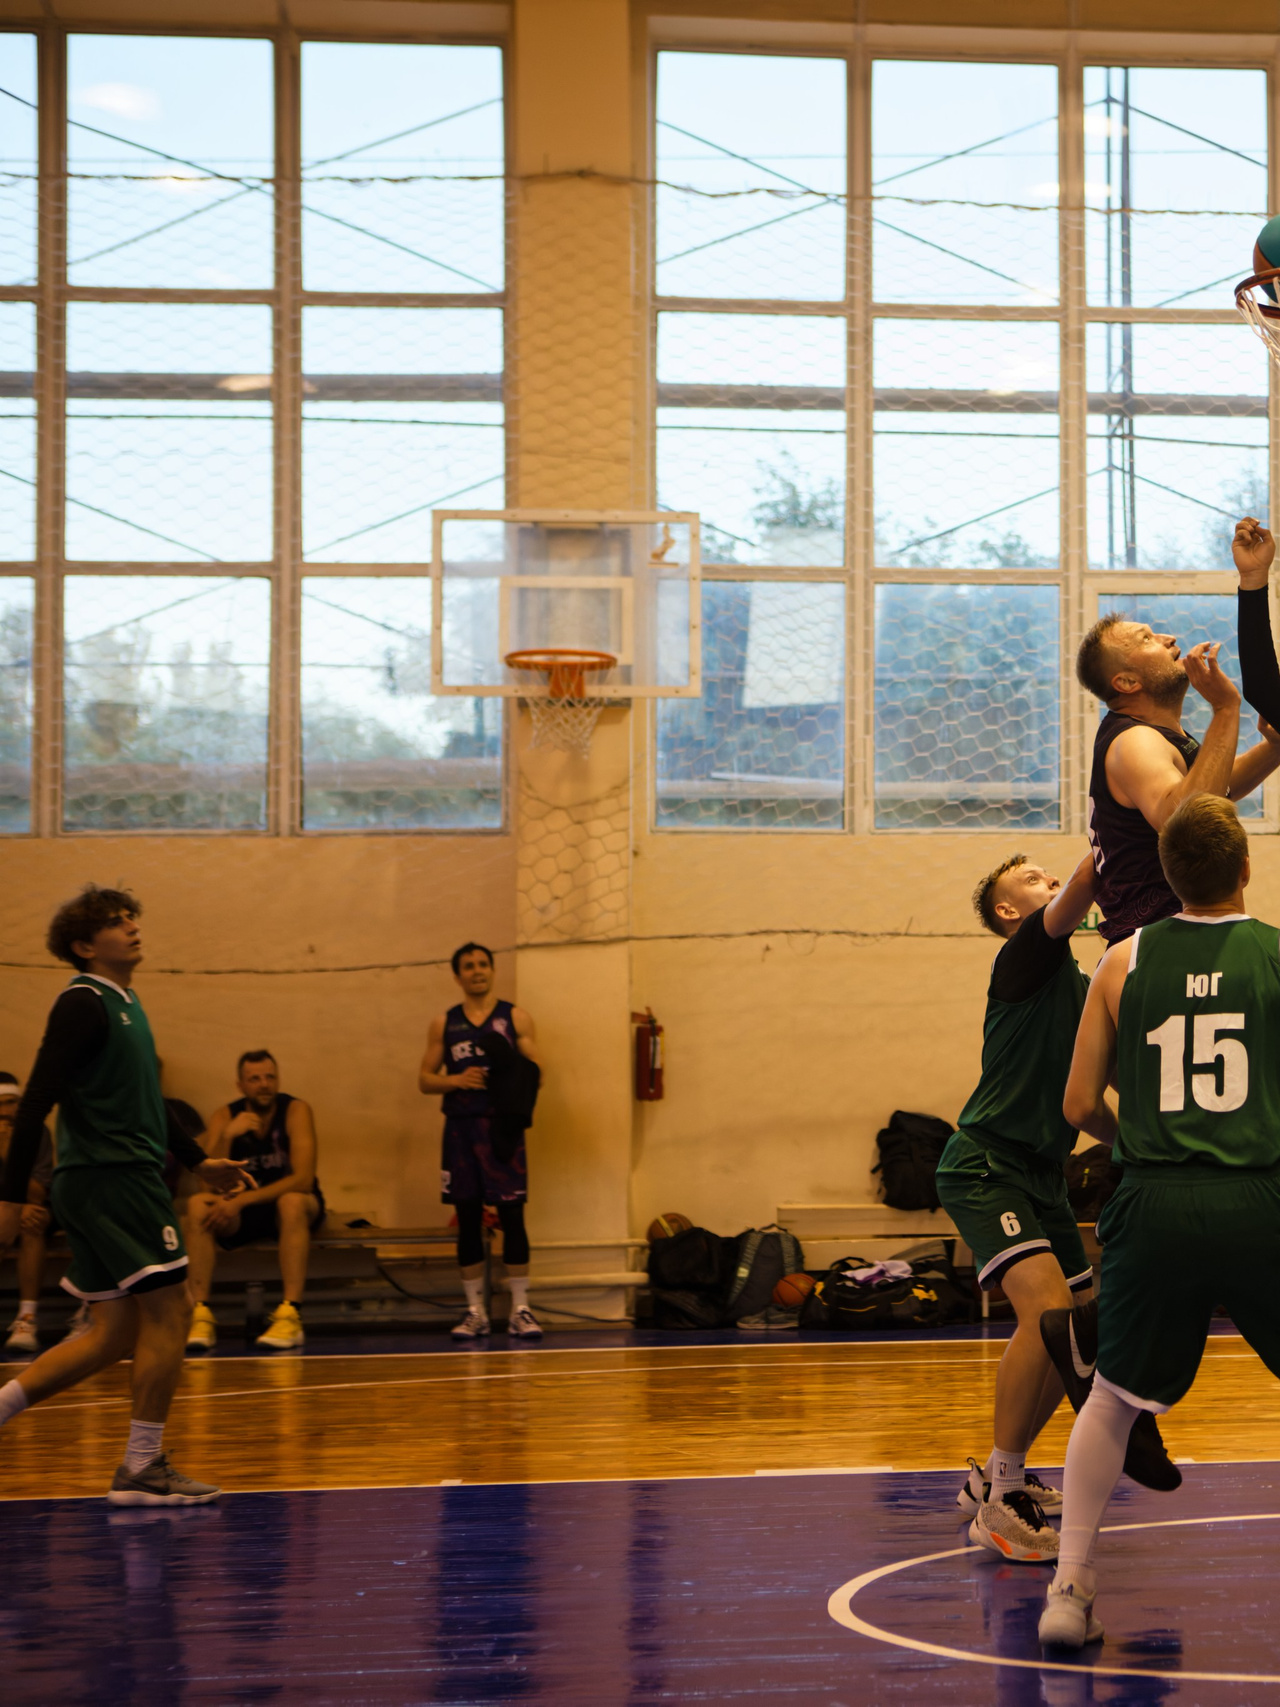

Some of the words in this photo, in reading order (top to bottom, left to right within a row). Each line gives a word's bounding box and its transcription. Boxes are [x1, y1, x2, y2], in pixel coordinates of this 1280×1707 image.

[1186, 971, 1223, 998] ЮГ
[1146, 1013, 1249, 1113] 15
[1000, 1211, 1021, 1237] 6
[162, 1225, 179, 1251] 9
